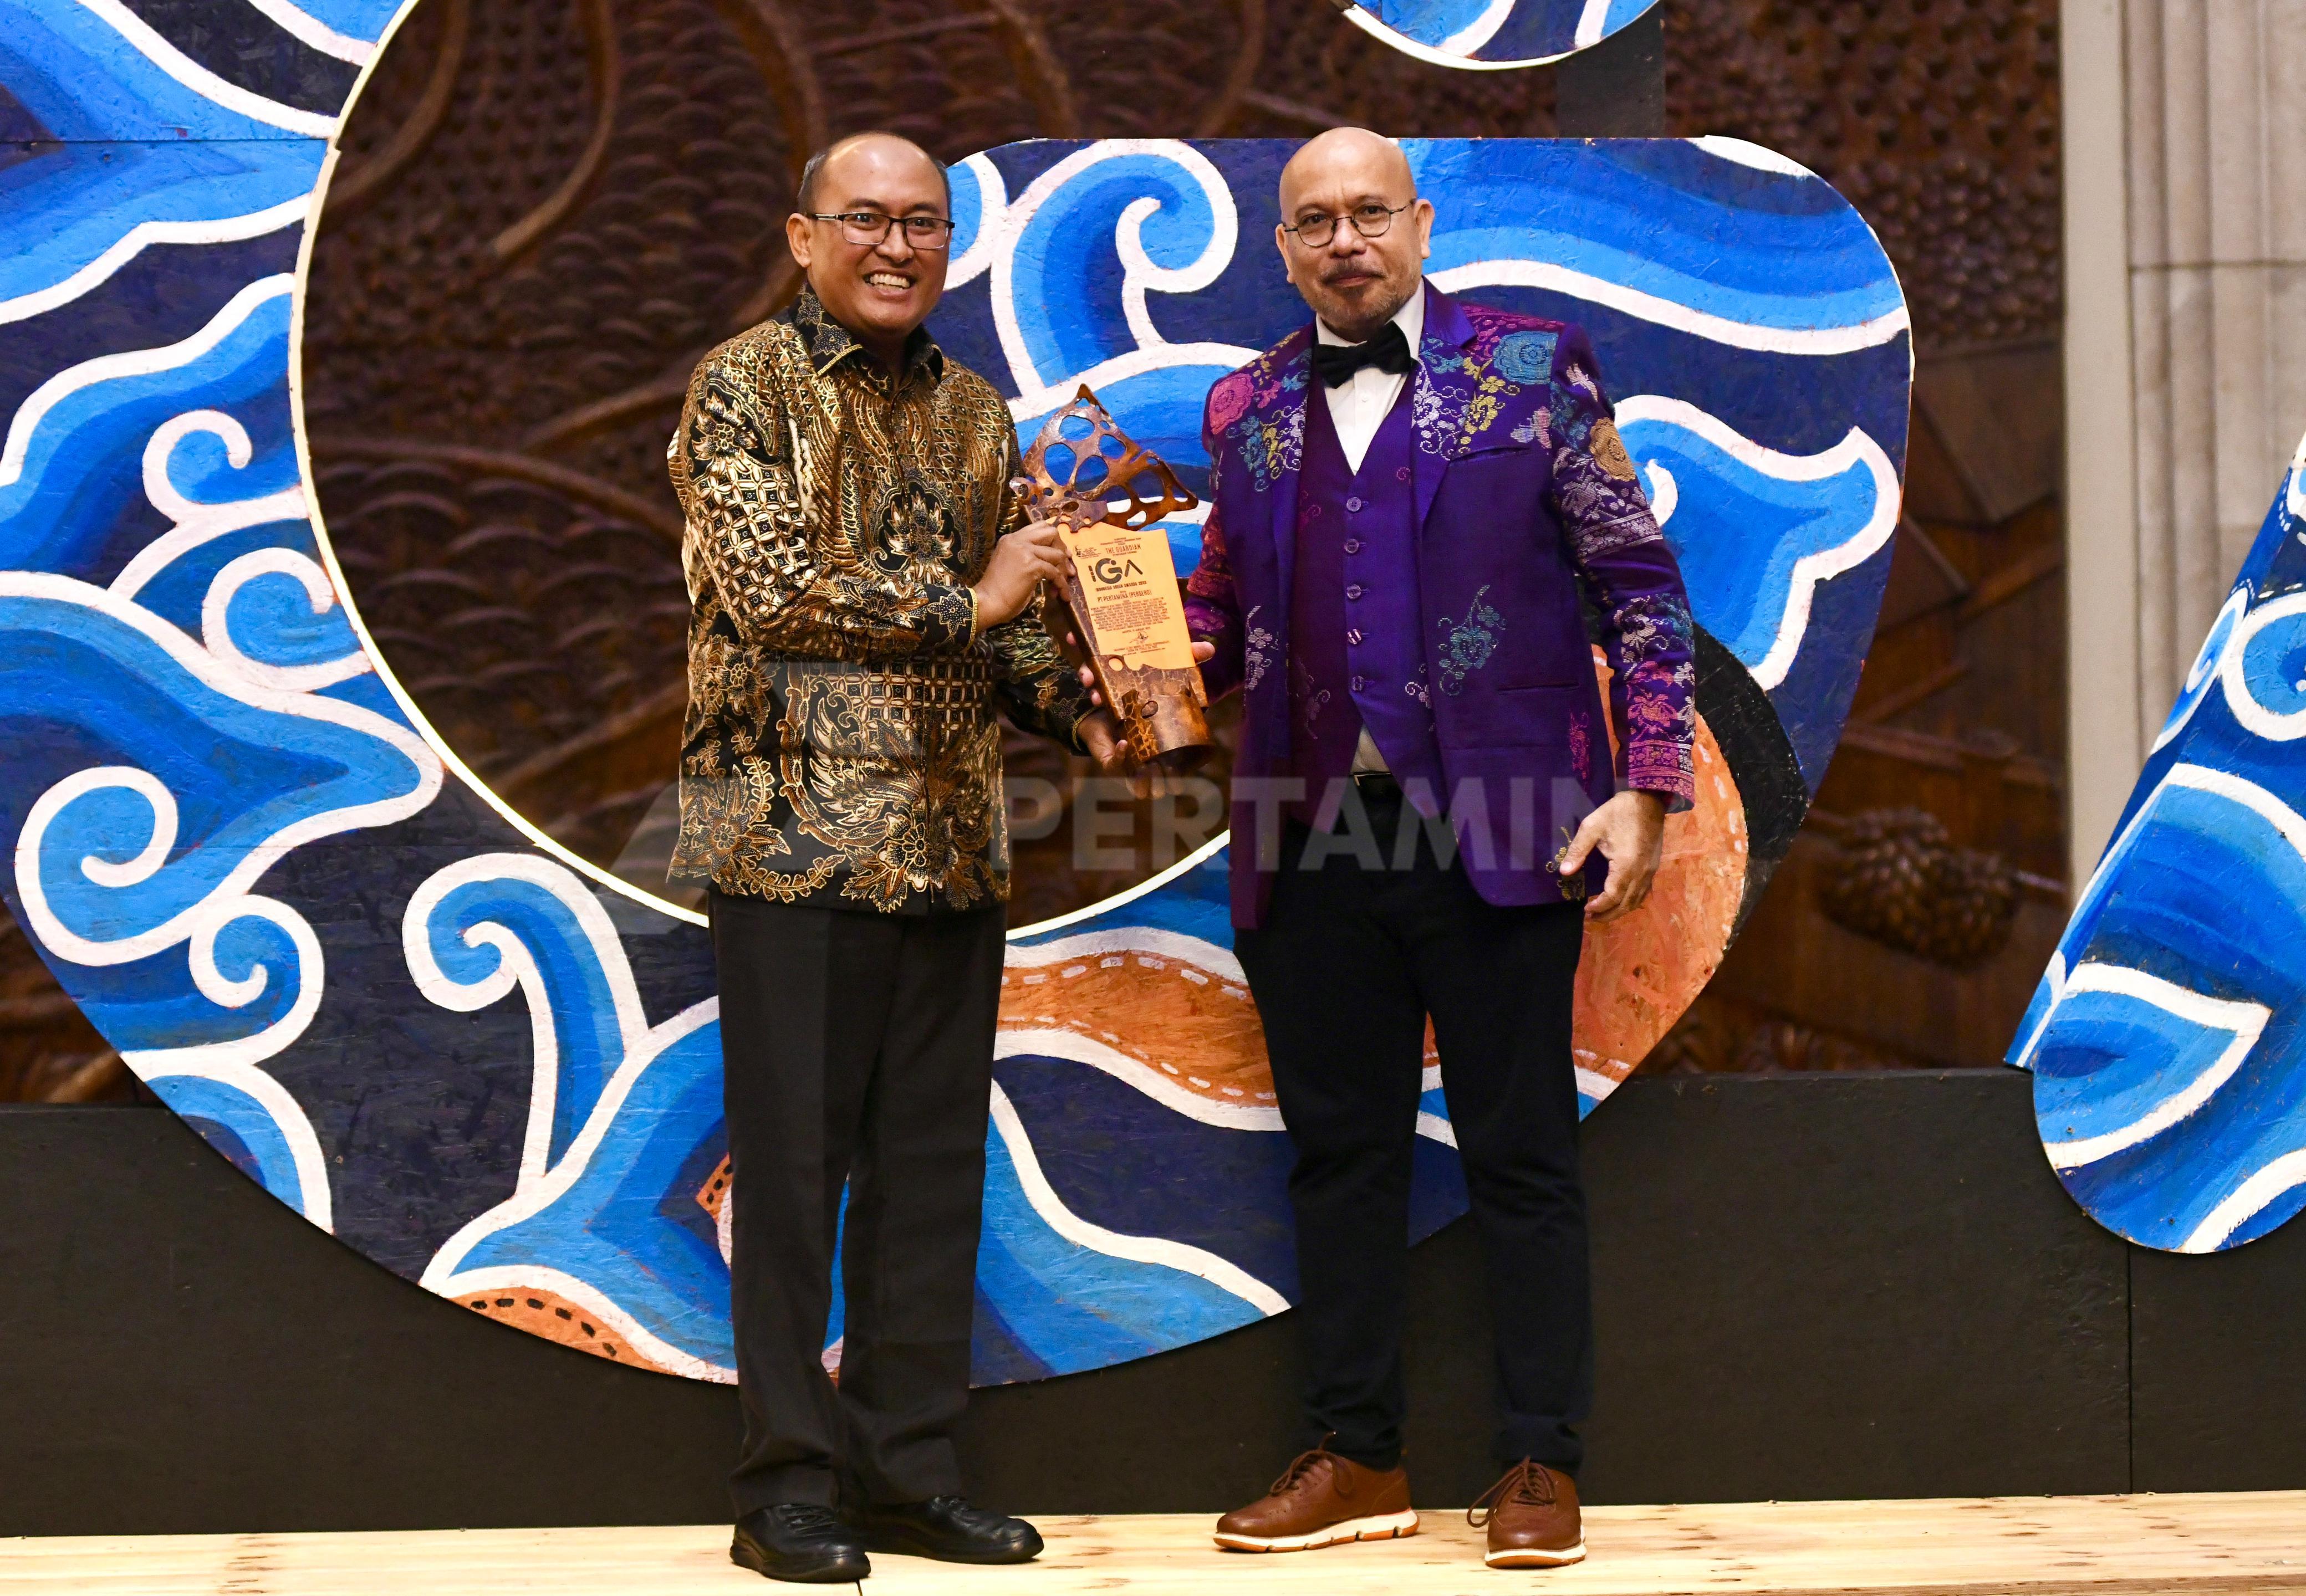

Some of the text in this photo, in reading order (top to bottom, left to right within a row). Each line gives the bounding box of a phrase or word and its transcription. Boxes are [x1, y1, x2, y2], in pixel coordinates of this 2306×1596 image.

[1115, 544, 1141, 553] GUARDIAN
[1103, 593, 1128, 602] PERTAMINA
[1129, 590, 1152, 598] (PERSERO)
